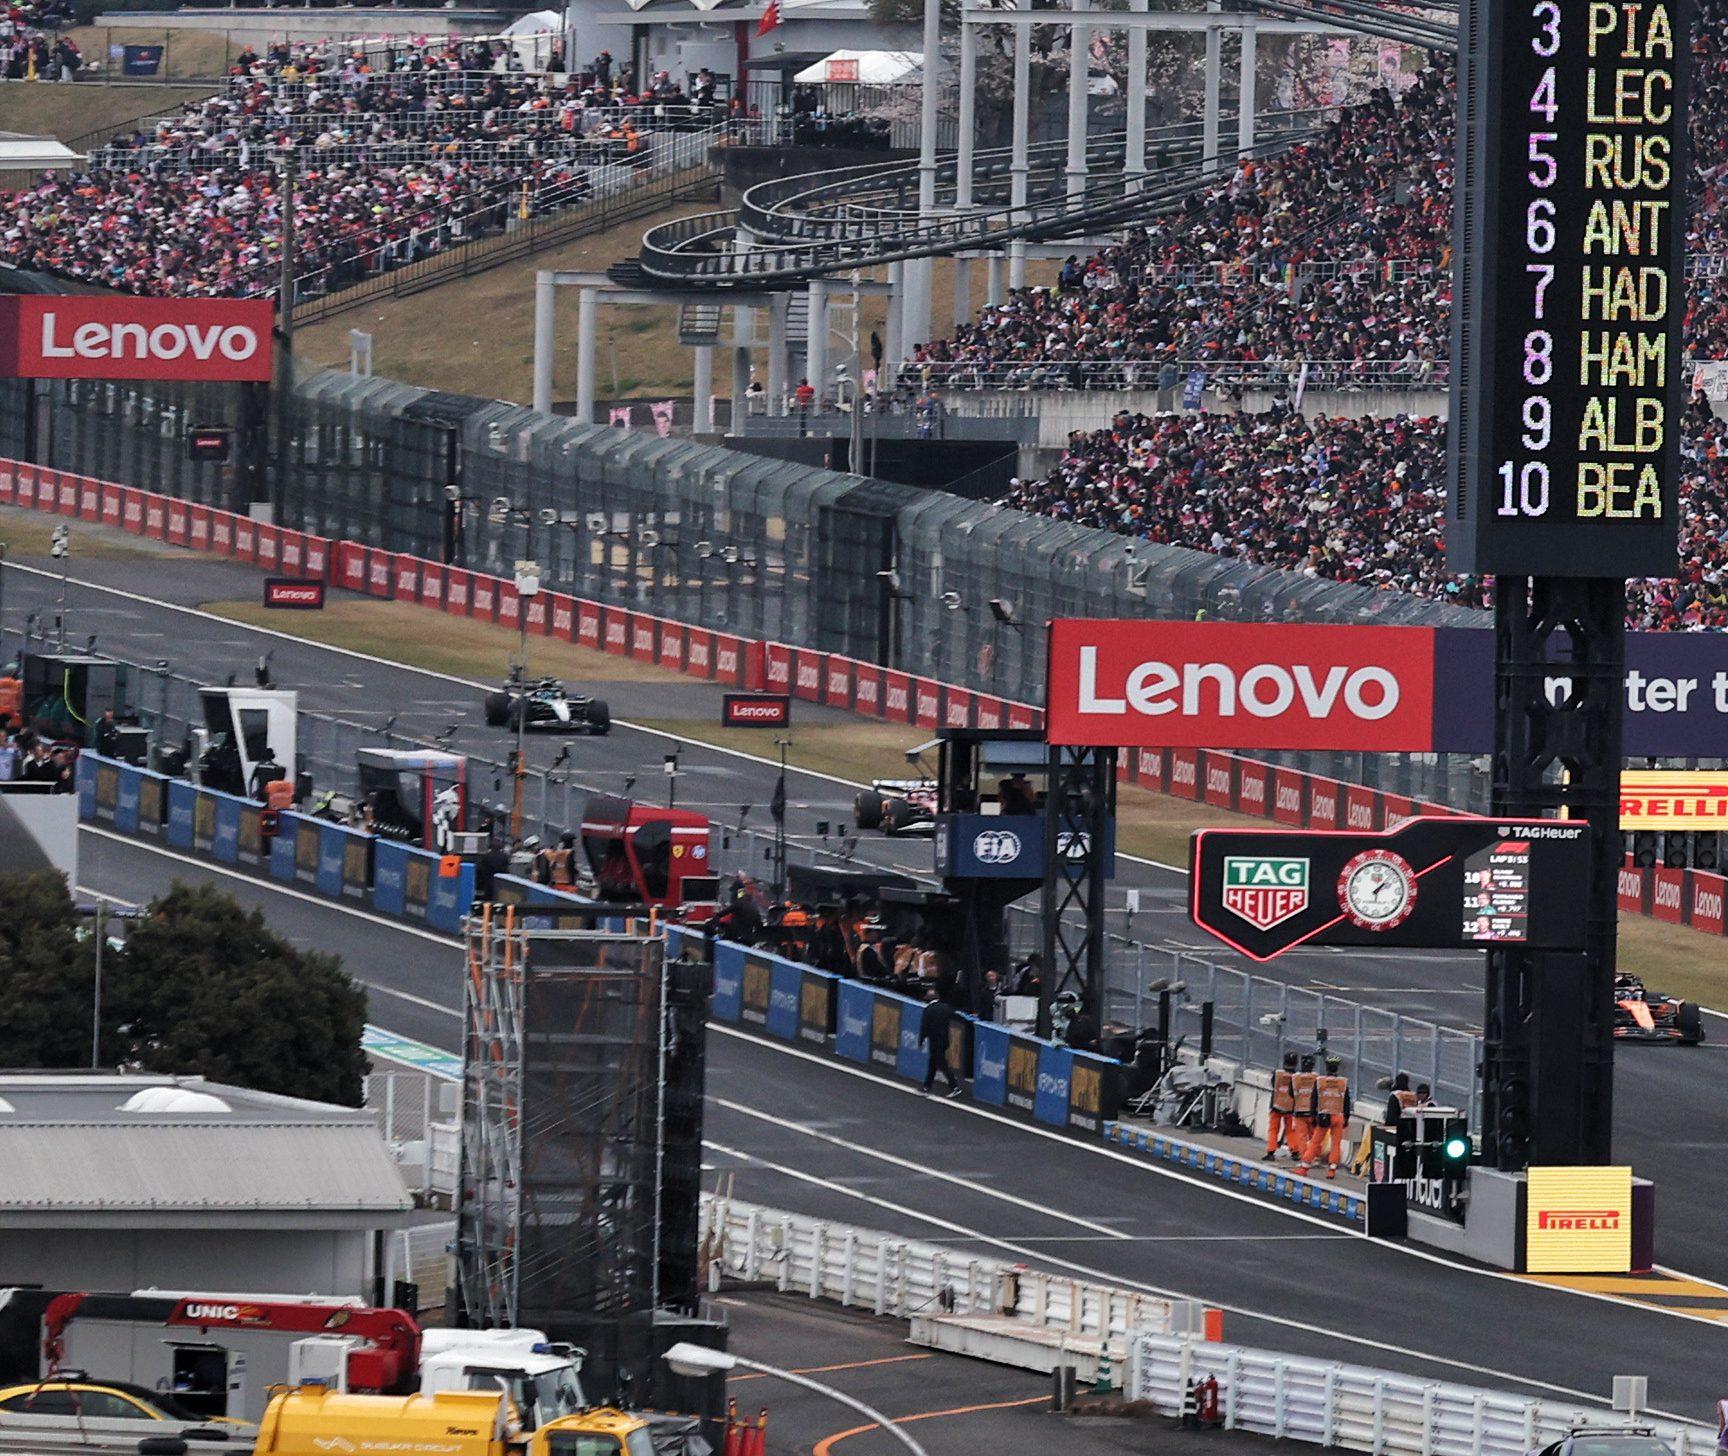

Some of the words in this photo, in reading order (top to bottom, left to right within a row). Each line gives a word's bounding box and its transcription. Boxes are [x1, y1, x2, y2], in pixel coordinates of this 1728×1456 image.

[1532, 3, 1560, 56] 3
[1589, 3, 1672, 58] PIA
[1530, 68, 1558, 122] 4
[1588, 68, 1671, 124] LEC
[1529, 133, 1557, 187] 5
[1586, 135, 1670, 189] RUS
[1527, 199, 1555, 253] 6
[1584, 201, 1669, 255] ANT
[1527, 265, 1554, 318] 7
[1582, 266, 1667, 321] HAD
[42, 313, 257, 361] Lenovo
[1524, 330, 1552, 384] 8
[1581, 331, 1665, 386] HAM
[1522, 396, 1551, 450] 9
[1579, 397, 1663, 452] ALB
[1498, 461, 1549, 516] 10
[1577, 463, 1661, 518] BEA
[273, 589, 316, 600] Lenovo
[1078, 646, 1400, 720] Lenovo
[733, 704, 780, 717] Lenovo
[1172, 754, 1195, 786] Lenovo
[1207, 763, 1230, 794] Lenovo
[1242, 771, 1264, 803] Lenovo
[1277, 779, 1300, 812] Lenovo
[1312, 788, 1335, 821] Lenovo
[1347, 796, 1372, 829] Lenovo
[1620, 785, 1728, 816] RELLI
[1231, 861, 1302, 884] TAG
[1618, 870, 1640, 899] enovo
[1228, 889, 1304, 924] HEUER
[1655, 873, 1681, 910] Lenovo
[1694, 884, 1722, 920] Lenovo
[1538, 1210, 1620, 1230] PIRELLI
[185, 1304, 240, 1320] UNIC
